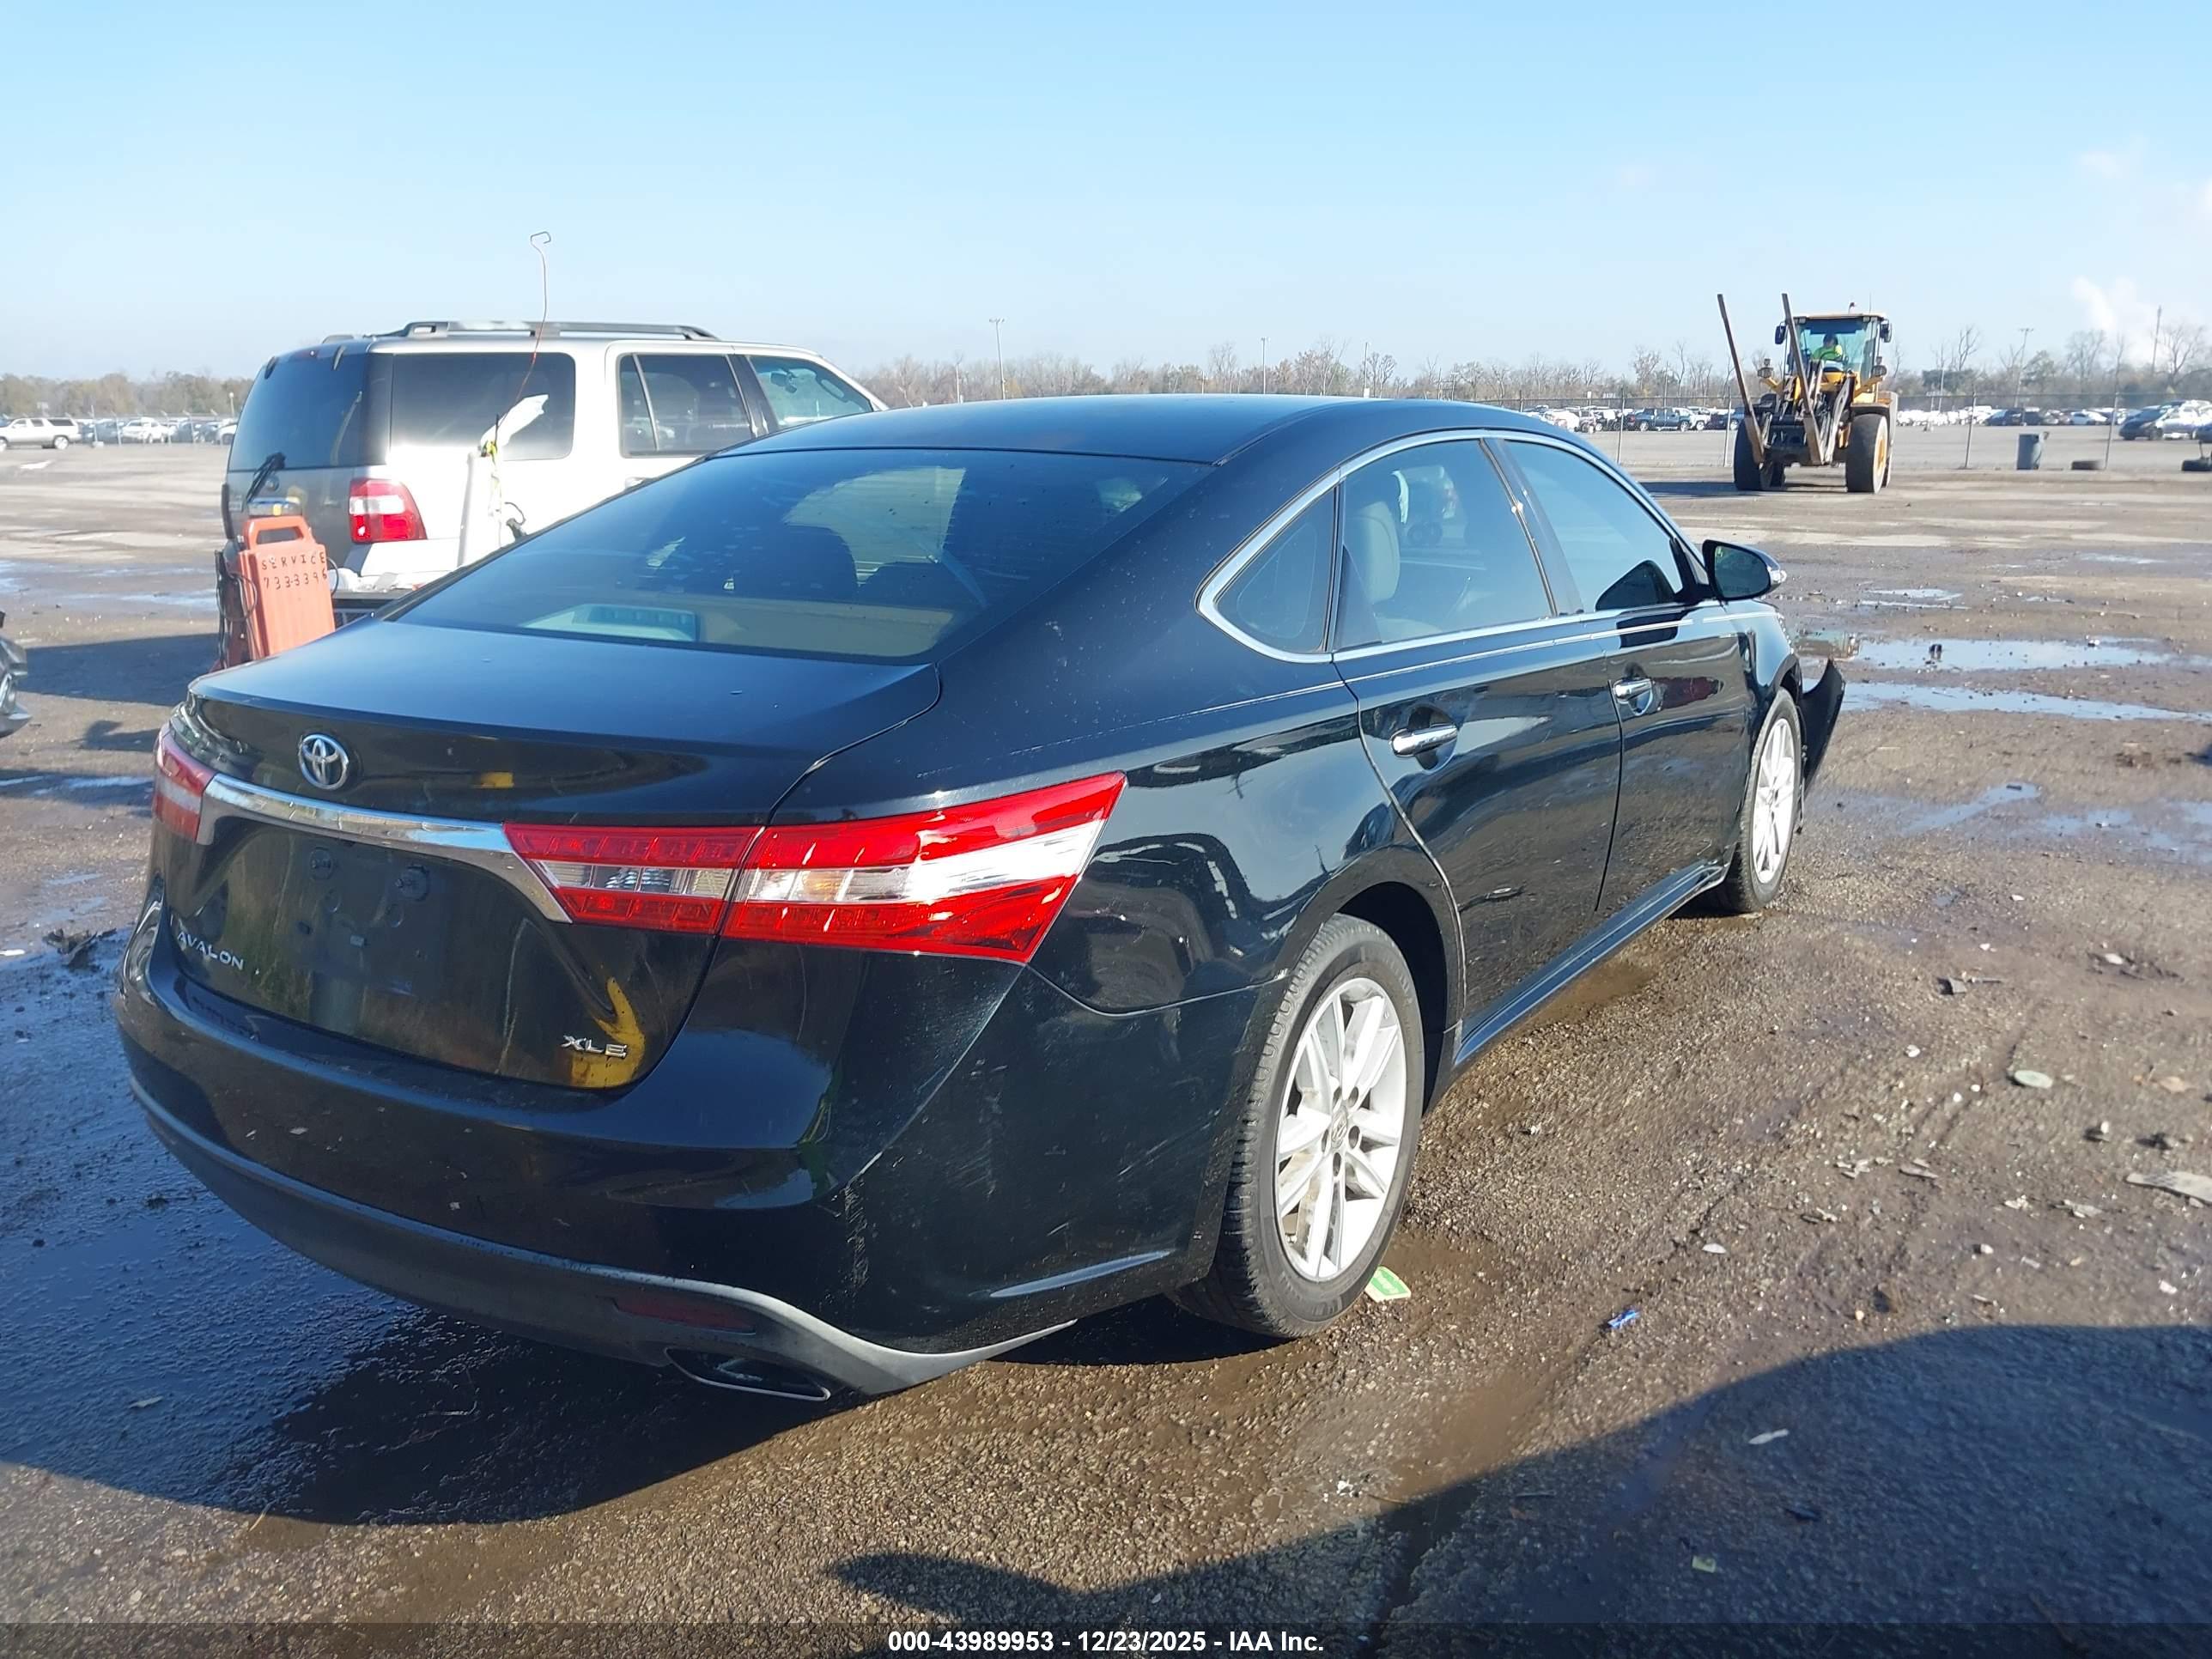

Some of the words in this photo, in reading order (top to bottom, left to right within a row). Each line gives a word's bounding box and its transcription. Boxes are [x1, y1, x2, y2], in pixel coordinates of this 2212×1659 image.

[261, 551, 325, 570] SERVICE
[177, 931, 244, 970] AVALON
[561, 1035, 627, 1058] XLE
